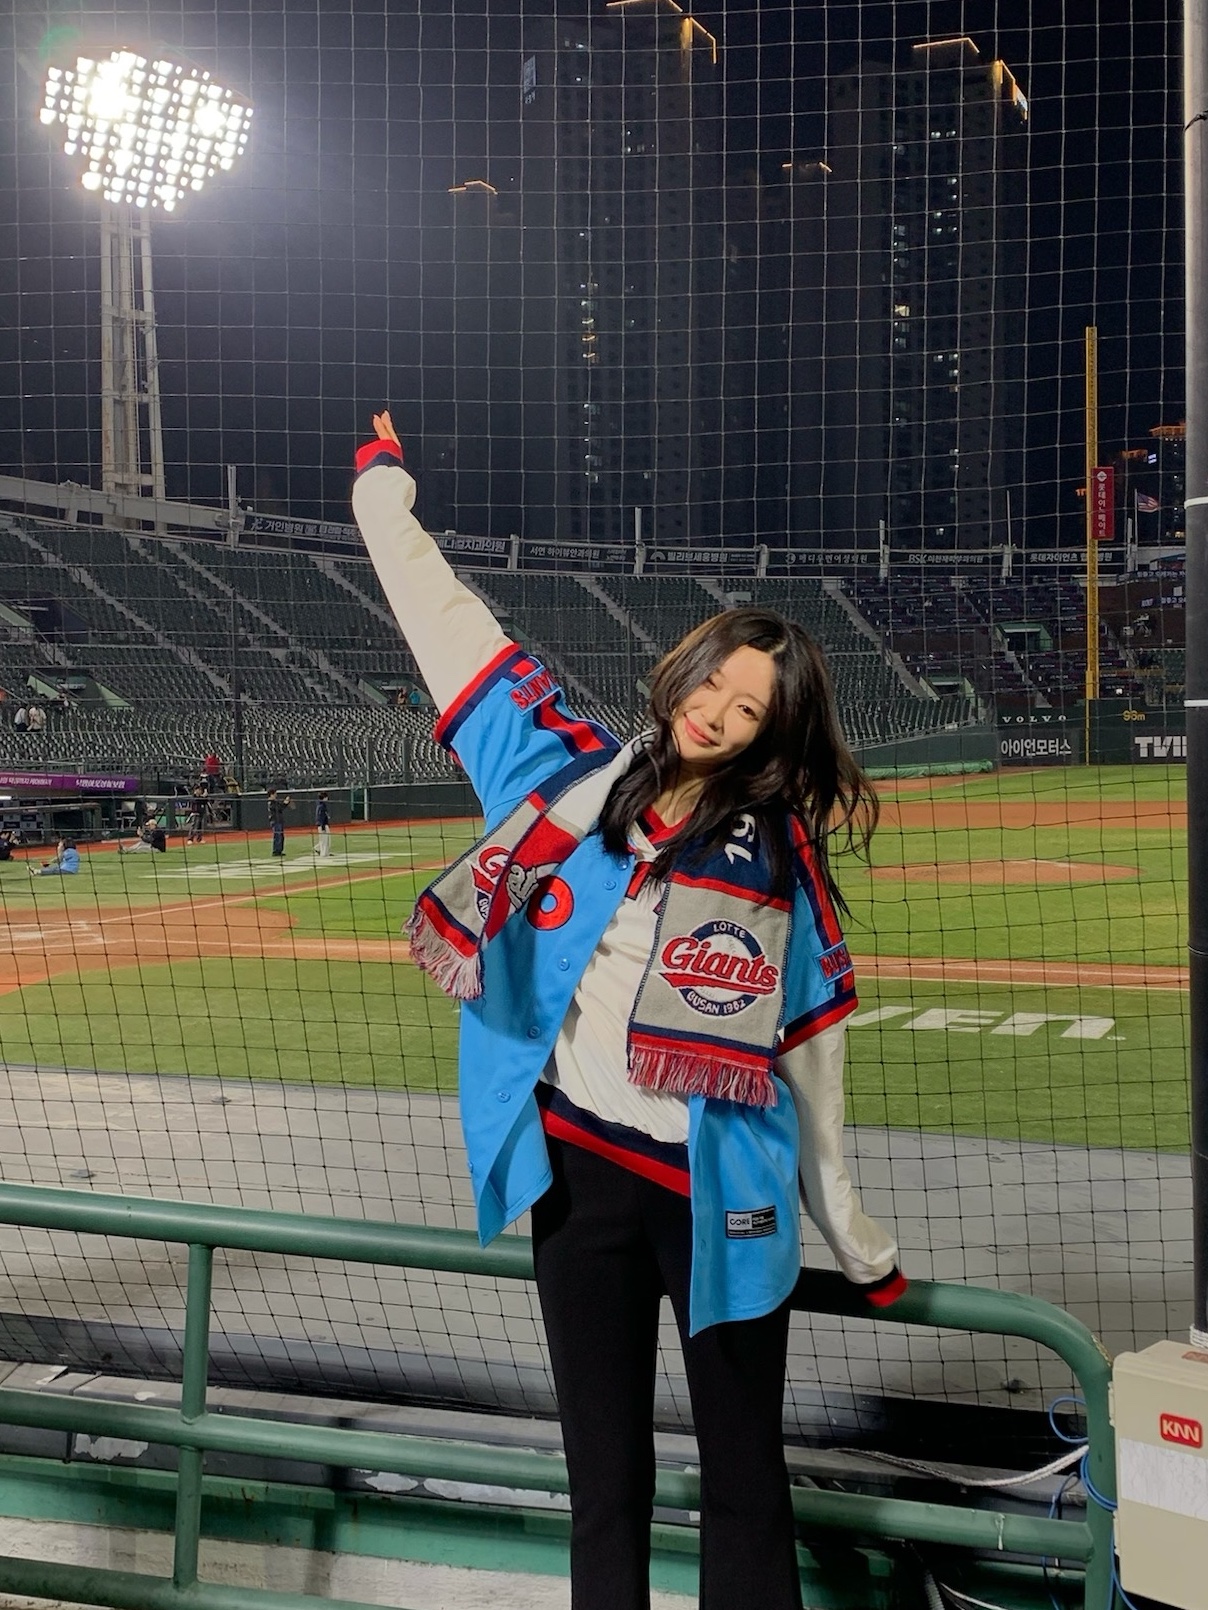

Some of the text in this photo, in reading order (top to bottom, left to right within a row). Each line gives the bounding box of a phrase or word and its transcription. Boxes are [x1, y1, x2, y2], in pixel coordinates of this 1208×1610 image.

[264, 520, 305, 534] 거인병원
[1029, 552, 1079, 563] 롯데자이언츠
[1002, 714, 1067, 724] VOLVO
[1000, 738, 1073, 757] 아이언모터스
[713, 922, 747, 939] LOTTE
[660, 935, 779, 988] Giants
[686, 990, 746, 1015] BUSAN 1982
[729, 1217, 751, 1226] CORE
[1161, 1418, 1200, 1443] KNN
